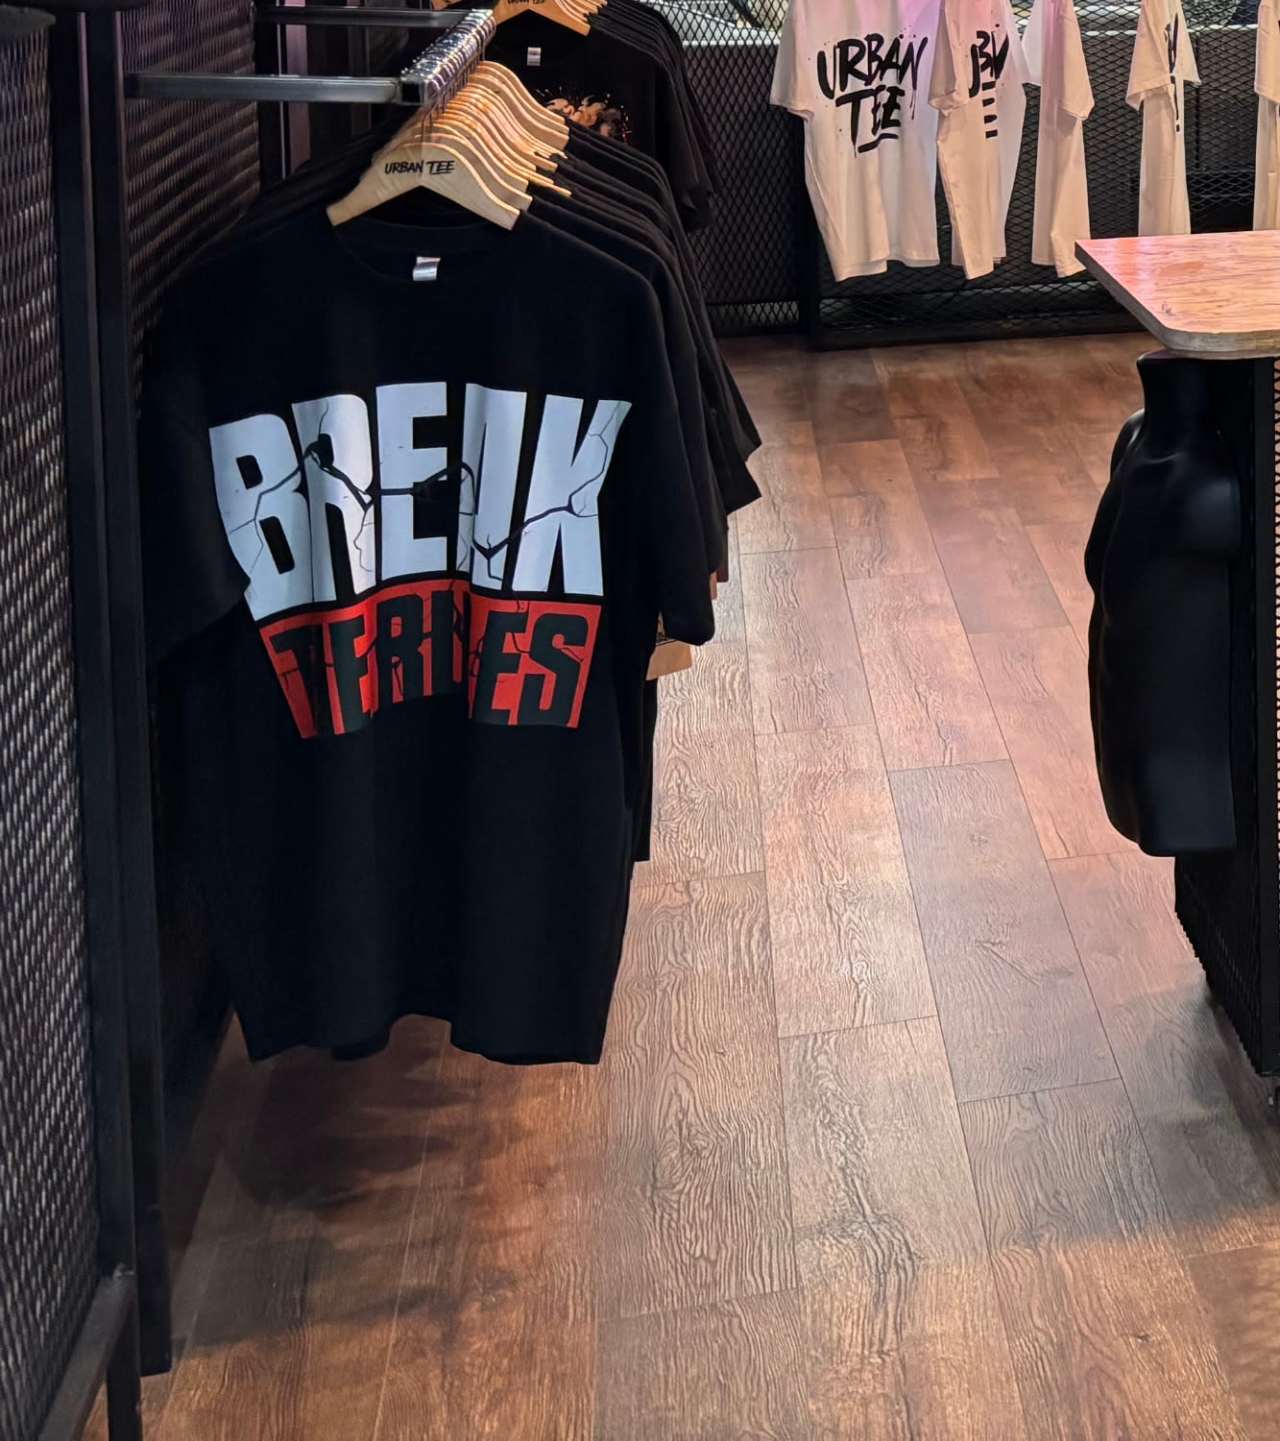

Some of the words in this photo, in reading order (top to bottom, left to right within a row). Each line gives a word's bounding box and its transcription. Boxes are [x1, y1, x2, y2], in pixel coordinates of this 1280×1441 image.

[817, 33, 928, 100] URBAN
[835, 85, 905, 154] TEE
[384, 160, 424, 175] URBAN
[426, 160, 456, 175] TEE
[209, 381, 631, 620] BREAK
